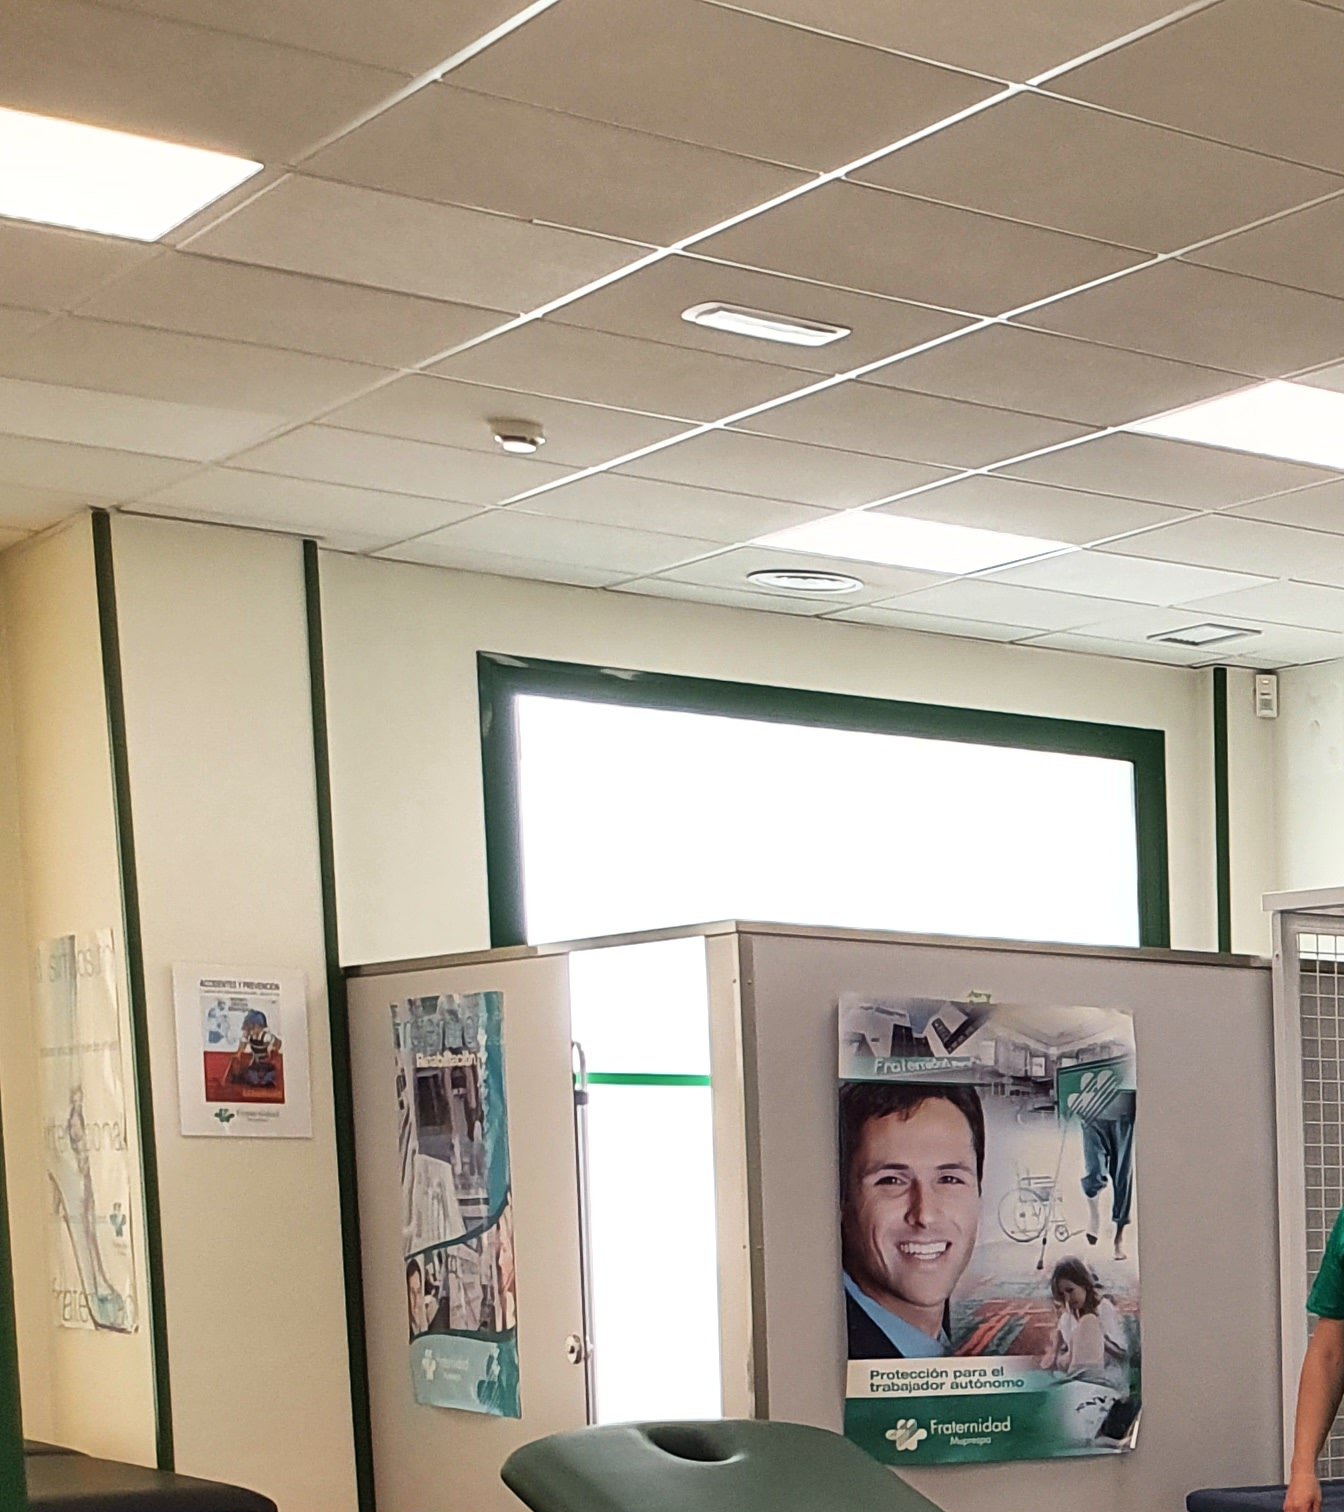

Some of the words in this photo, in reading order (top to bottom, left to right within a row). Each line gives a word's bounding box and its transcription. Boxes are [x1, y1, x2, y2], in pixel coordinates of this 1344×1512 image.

[870, 1368, 949, 1380] Protección
[953, 1370, 987, 1379] para
[991, 1366, 1004, 1377] el
[870, 1381, 946, 1393] trabajador
[950, 1378, 1025, 1390] autónomo
[930, 1416, 1011, 1435] Fraternidad
